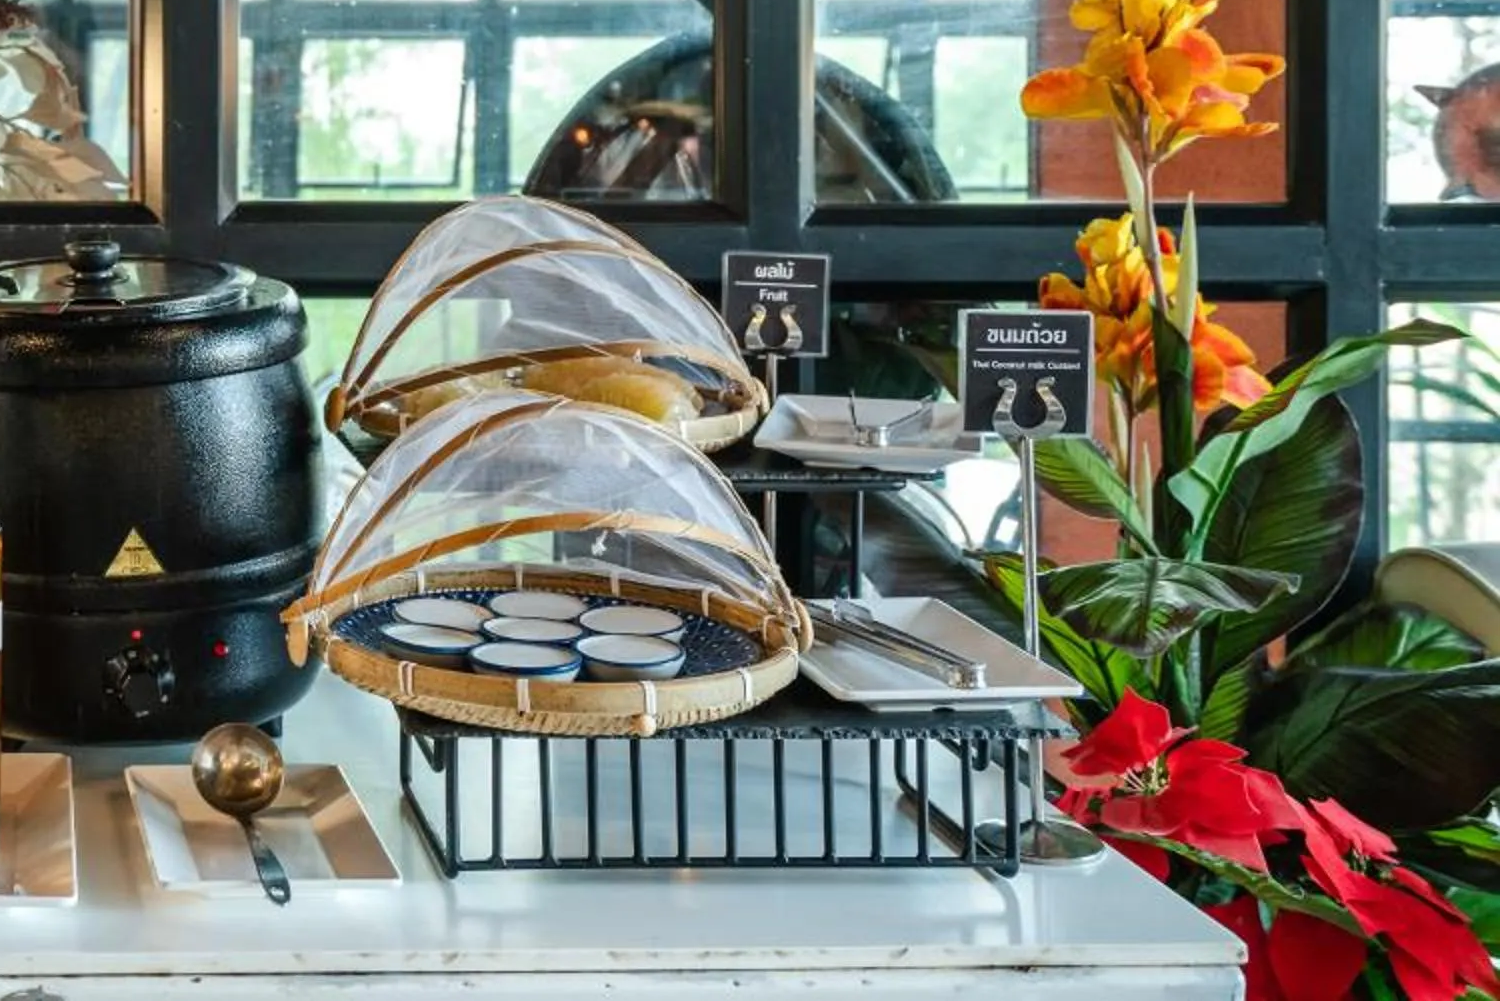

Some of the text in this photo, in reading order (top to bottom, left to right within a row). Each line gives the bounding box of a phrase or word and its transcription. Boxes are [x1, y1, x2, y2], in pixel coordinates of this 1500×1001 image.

[755, 261, 795, 279] ผลไม้
[759, 288, 788, 302] Fruit
[987, 322, 1067, 344] ขนมถ้วย
